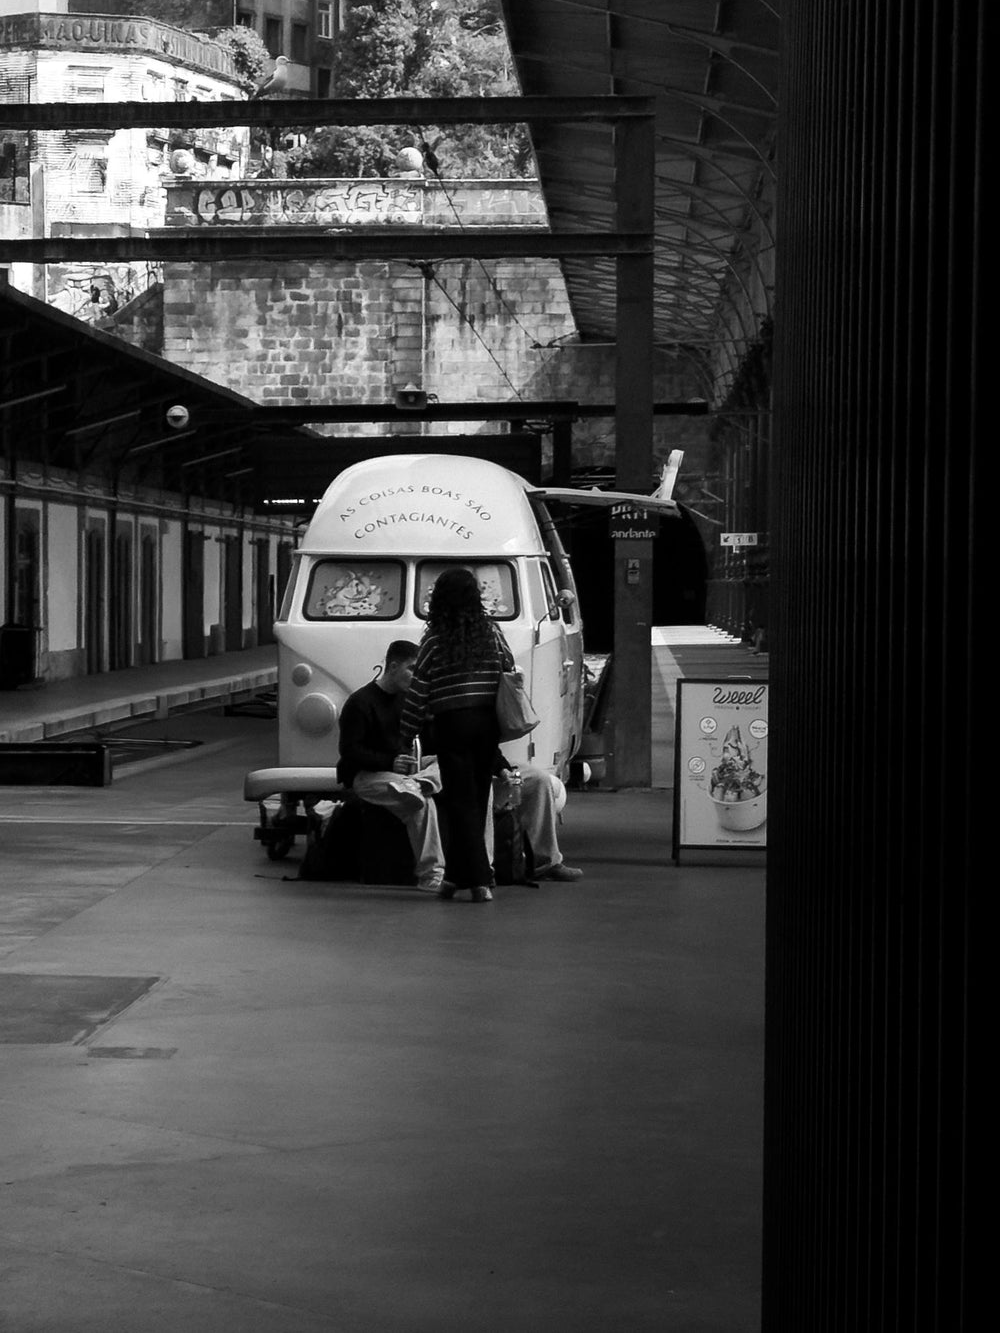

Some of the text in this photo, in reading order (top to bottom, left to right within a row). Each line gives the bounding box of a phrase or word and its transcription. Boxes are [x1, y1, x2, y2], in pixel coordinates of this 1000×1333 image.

[340, 485, 492, 522] AS COISAS BOAS SÃO
[354, 512, 474, 540] CONTAGIANTES
